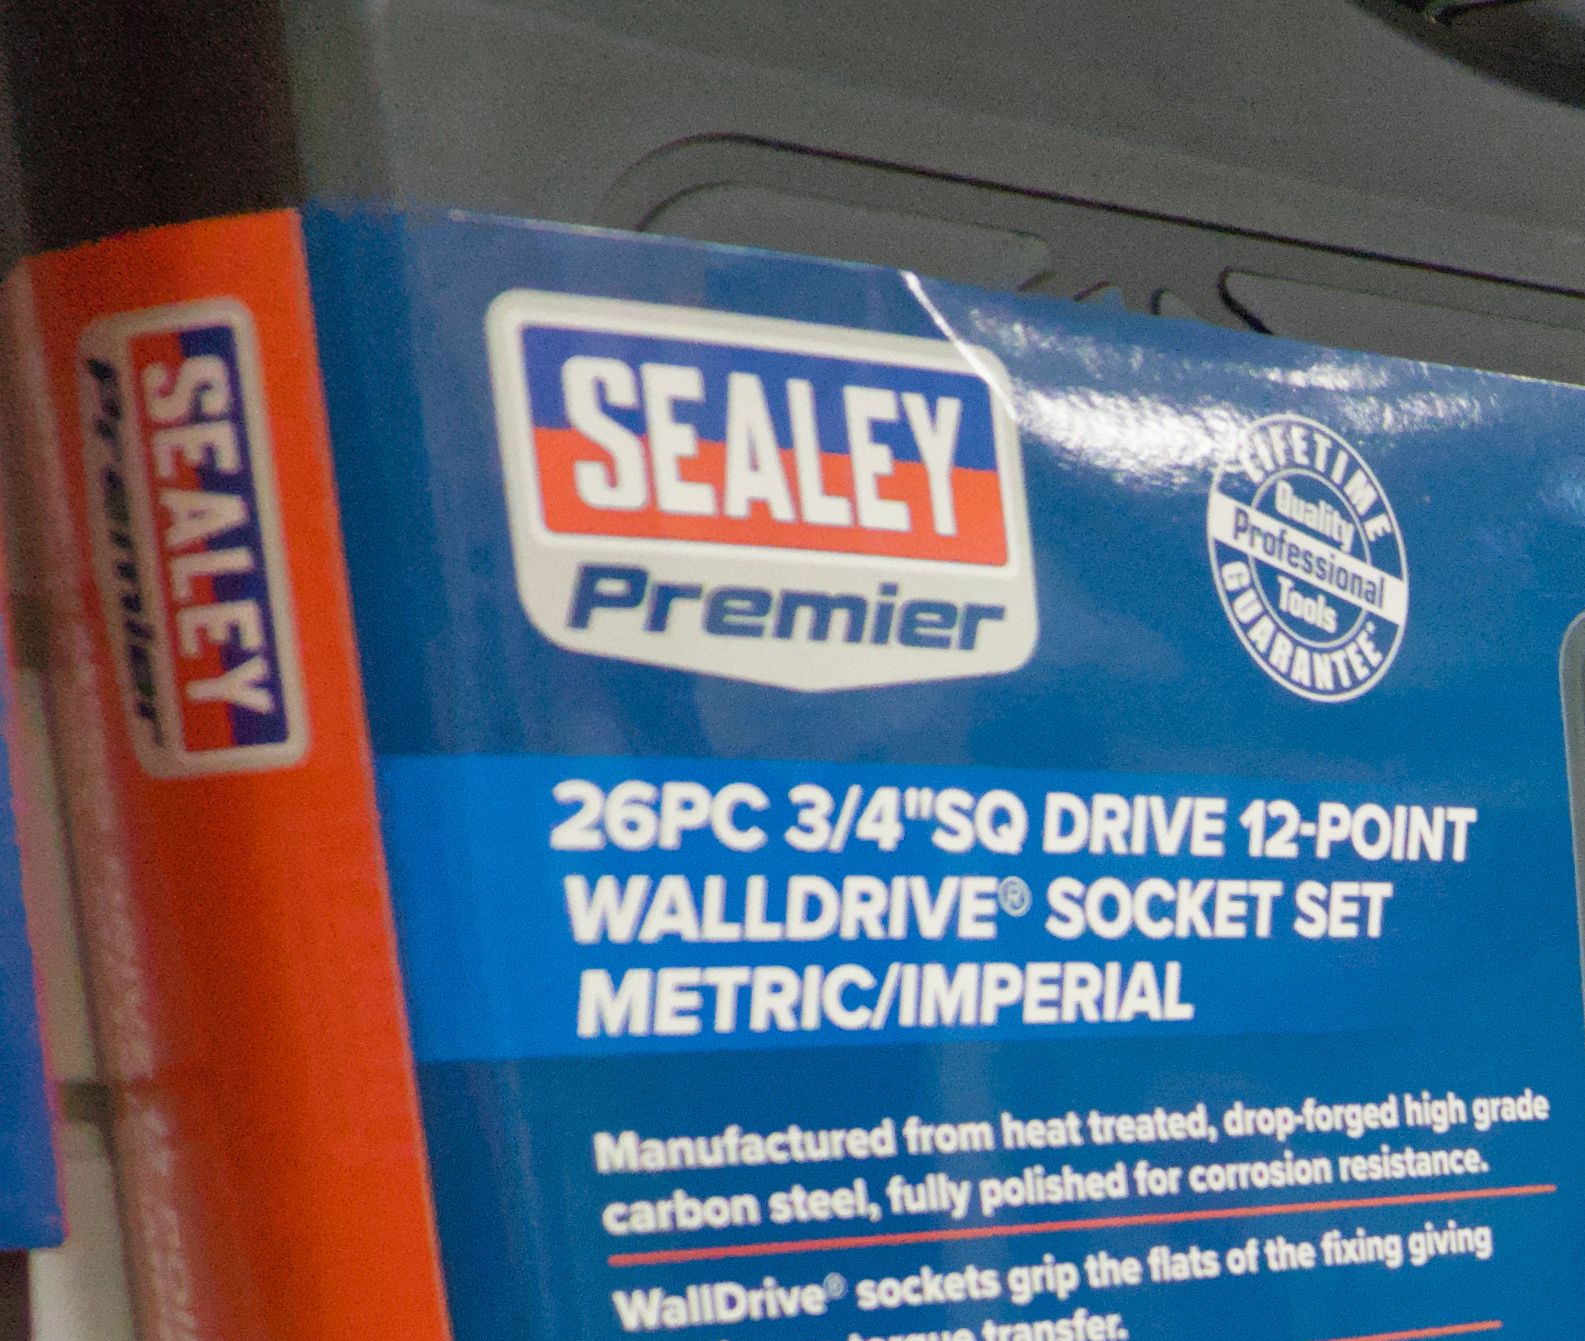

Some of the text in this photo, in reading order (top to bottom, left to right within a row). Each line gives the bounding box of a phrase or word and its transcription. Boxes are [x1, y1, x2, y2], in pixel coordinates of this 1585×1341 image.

[564, 353, 962, 538] SEALEY
[143, 352, 274, 714] SEALEY
[1233, 507, 1384, 609] Professional
[566, 564, 1005, 654] Premier
[1277, 576, 1338, 634] Tools
[552, 781, 1477, 861] 26PC 3/4"SQ DRIVE 12-POINT
[1045, 880, 1283, 939] SOCKET
[1294, 880, 1392, 937] SET
[576, 960, 1195, 1037] METRIC/IMPERIAL
[594, 1088, 1549, 1174] Manufactured from heat treated, drop-forged high grade
[602, 1143, 1489, 1235] carbon steel, fully polished for corrosion resistance.
[855, 1261, 1001, 1312] sockets
[1008, 1253, 1078, 1304] grip
[1084, 1248, 1142, 1289] the
[1146, 1243, 1220, 1286] flats
[1226, 1239, 1259, 1275] of
[1263, 1232, 1317, 1273] the
[1320, 1227, 1401, 1273] fixing
[1407, 1221, 1493, 1263] giving
